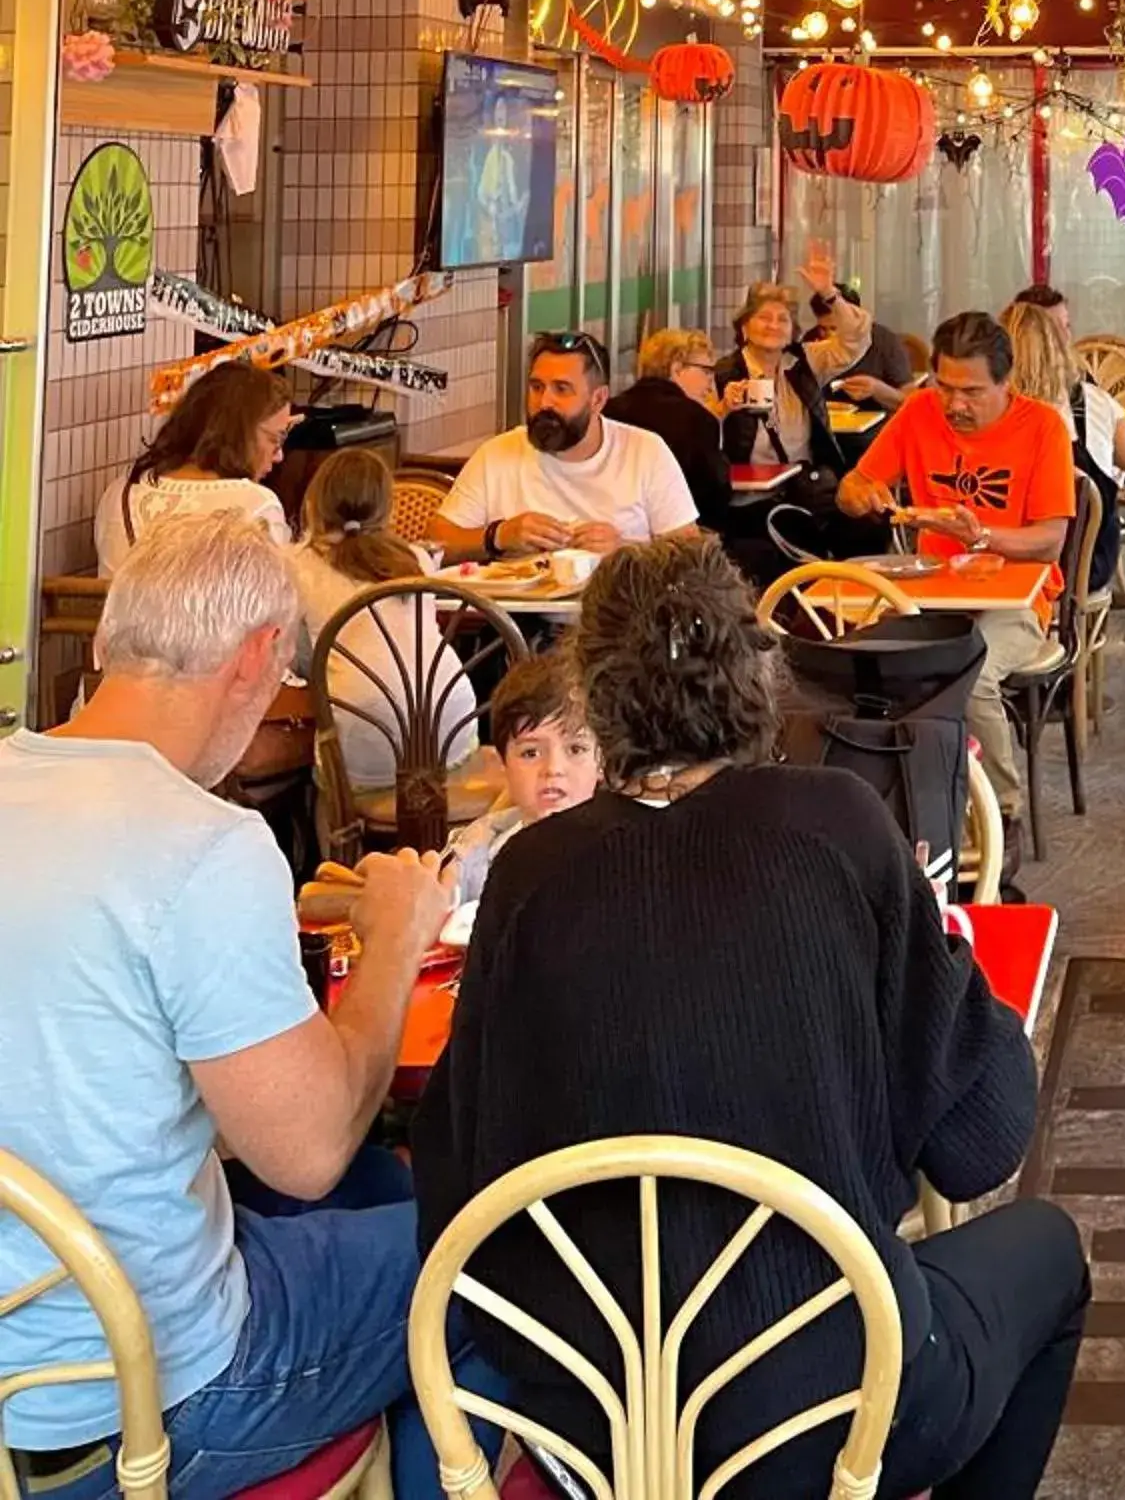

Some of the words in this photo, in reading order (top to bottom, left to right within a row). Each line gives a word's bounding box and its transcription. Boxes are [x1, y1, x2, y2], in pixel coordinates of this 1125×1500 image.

[70, 293, 81, 319] 2
[83, 287, 145, 317] TOWNS
[69, 313, 145, 338] CIDERHOUSE
